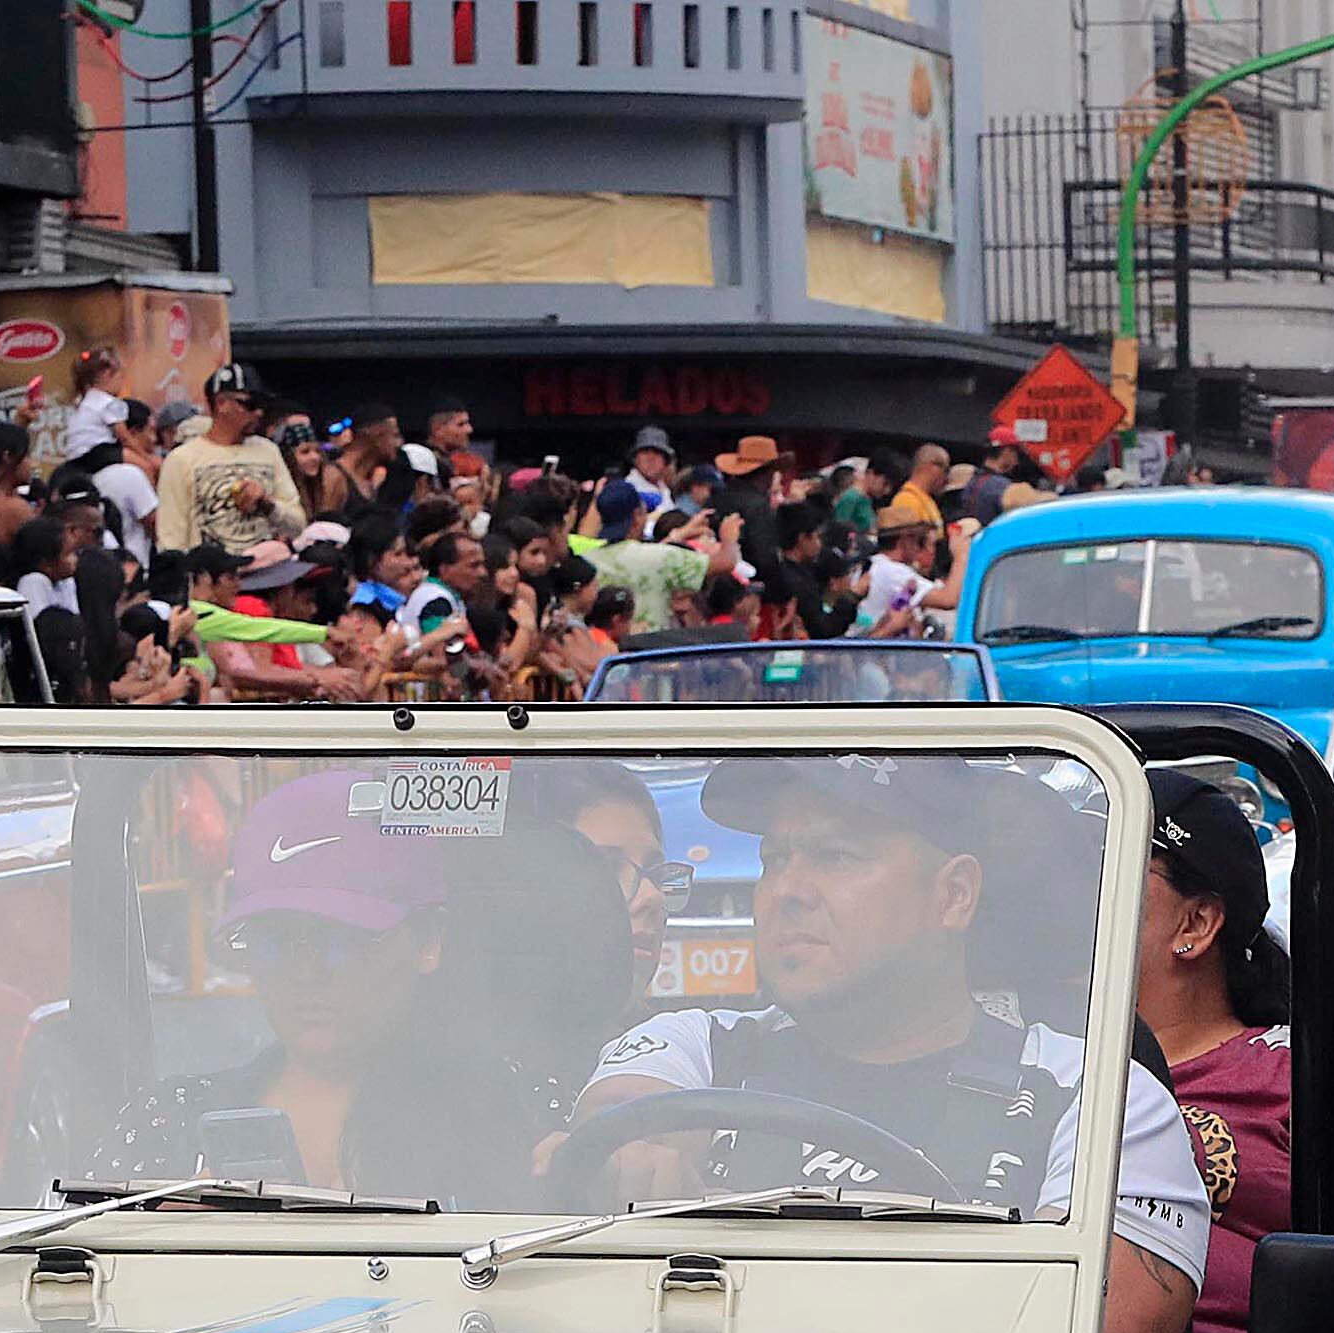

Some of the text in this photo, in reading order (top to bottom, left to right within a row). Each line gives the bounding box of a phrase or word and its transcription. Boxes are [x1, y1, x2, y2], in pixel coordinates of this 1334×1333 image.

[523, 369, 771, 416] HELADOS
[420, 761, 496, 771] COSTA RICA
[391, 774, 499, 811] 038304
[689, 949, 749, 977] 007
